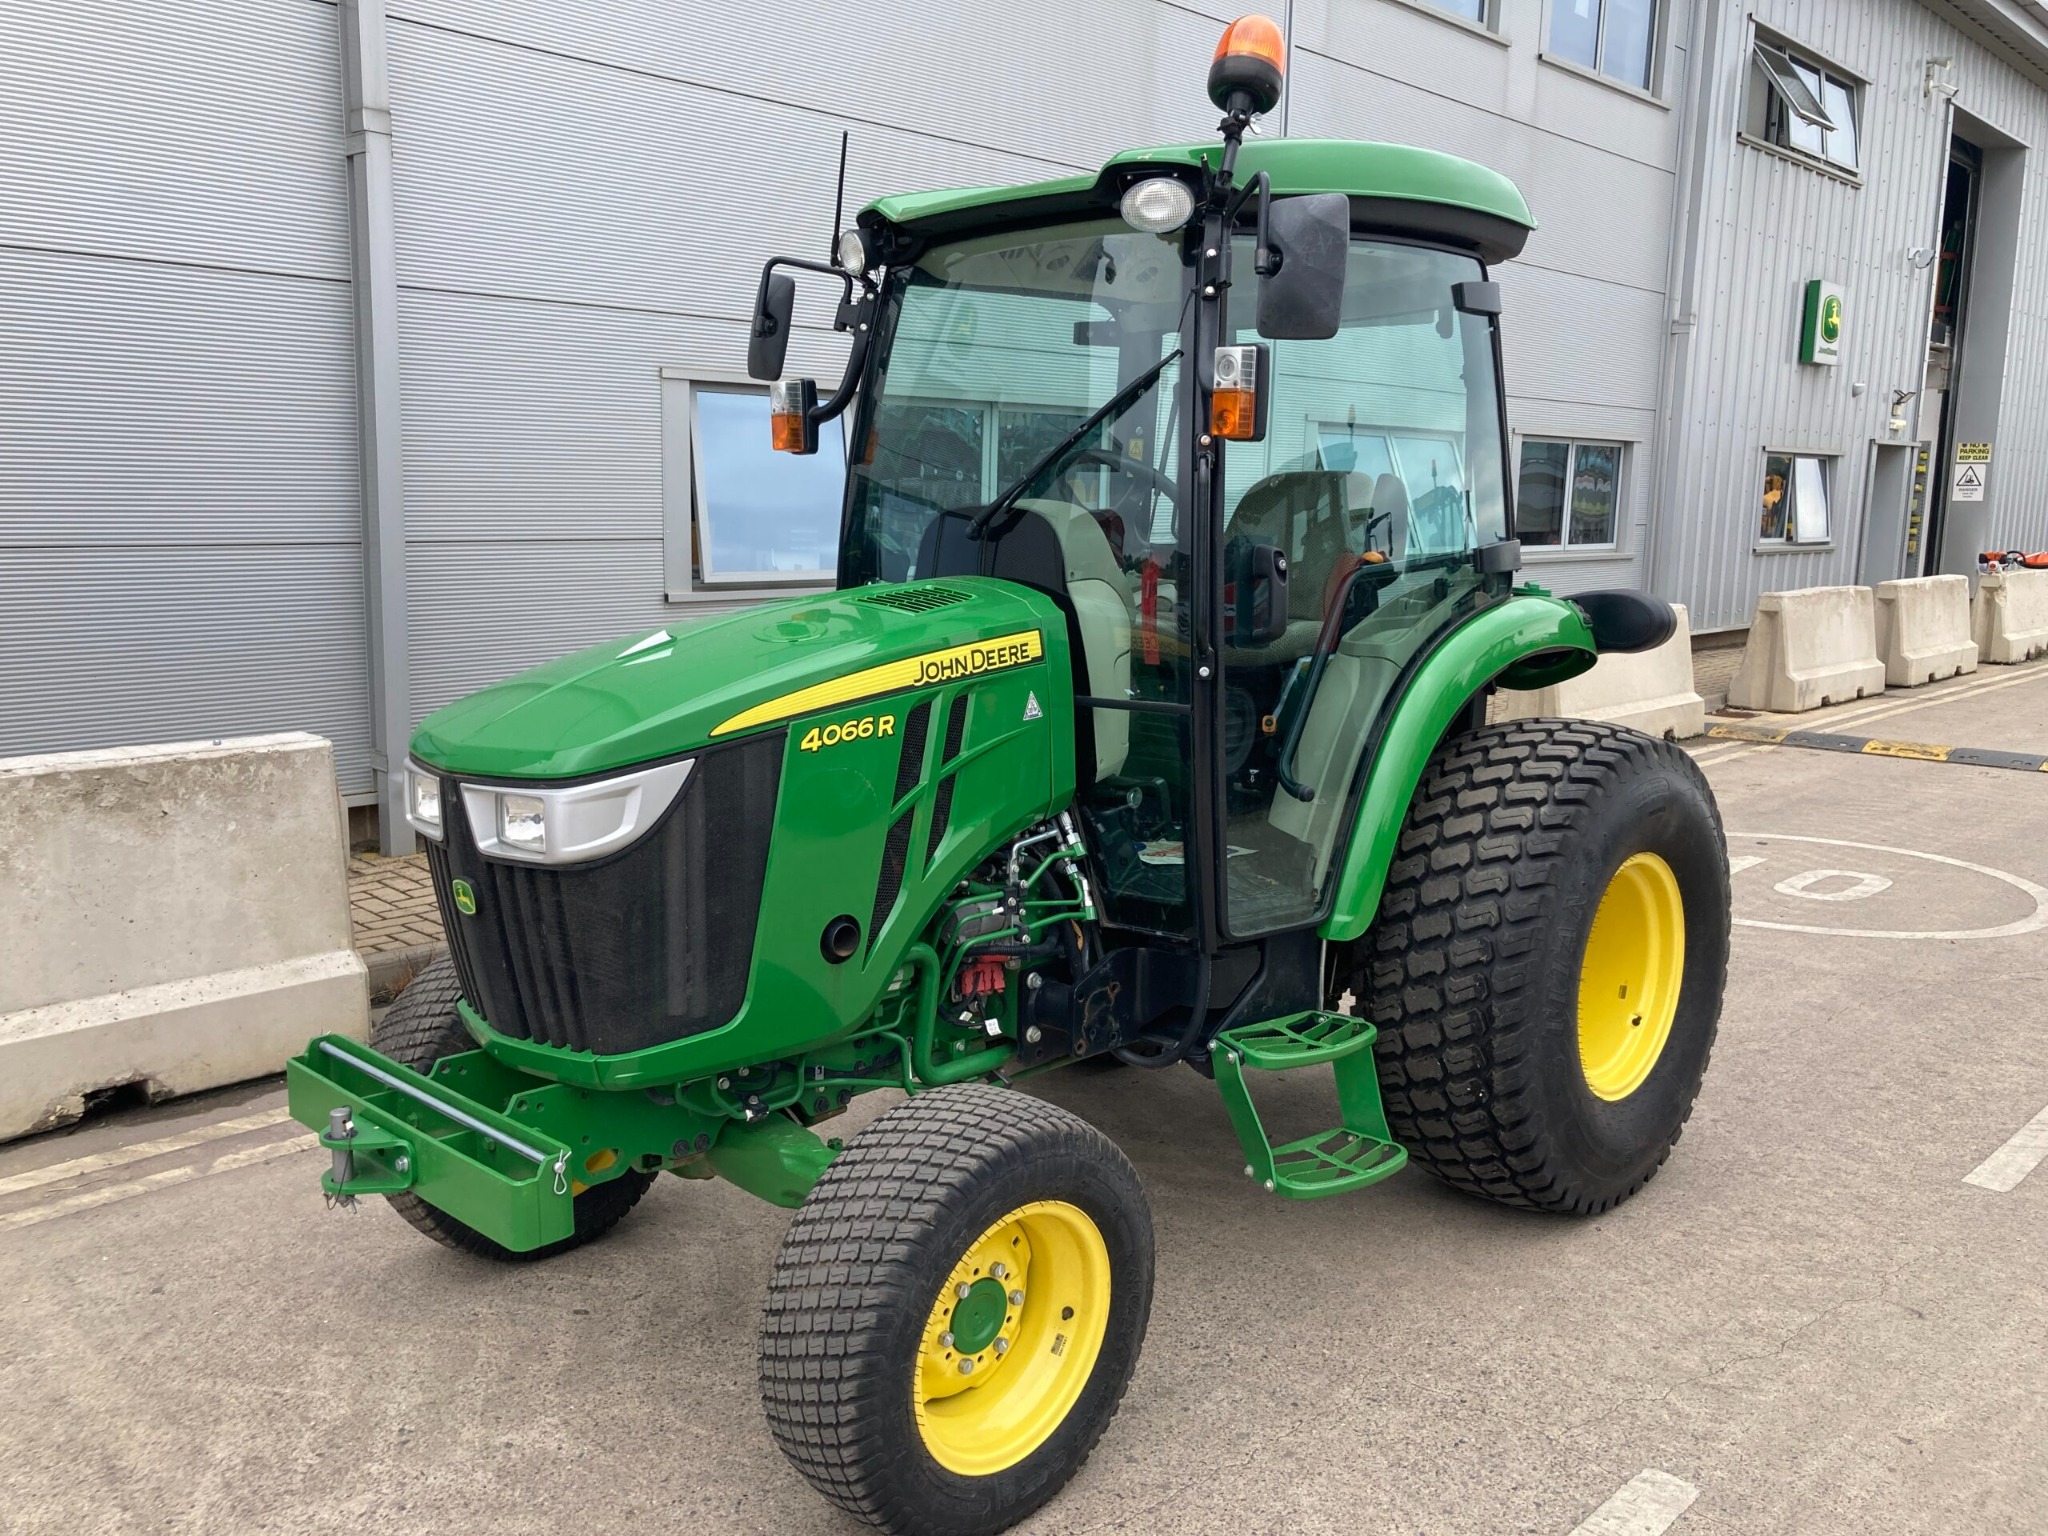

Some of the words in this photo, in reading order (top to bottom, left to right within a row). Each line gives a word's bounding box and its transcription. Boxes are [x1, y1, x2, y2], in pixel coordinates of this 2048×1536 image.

[914, 654, 968, 685] JOHN
[971, 643, 1030, 673] DEERE
[800, 717, 874, 753] 4066
[877, 714, 896, 738] R
